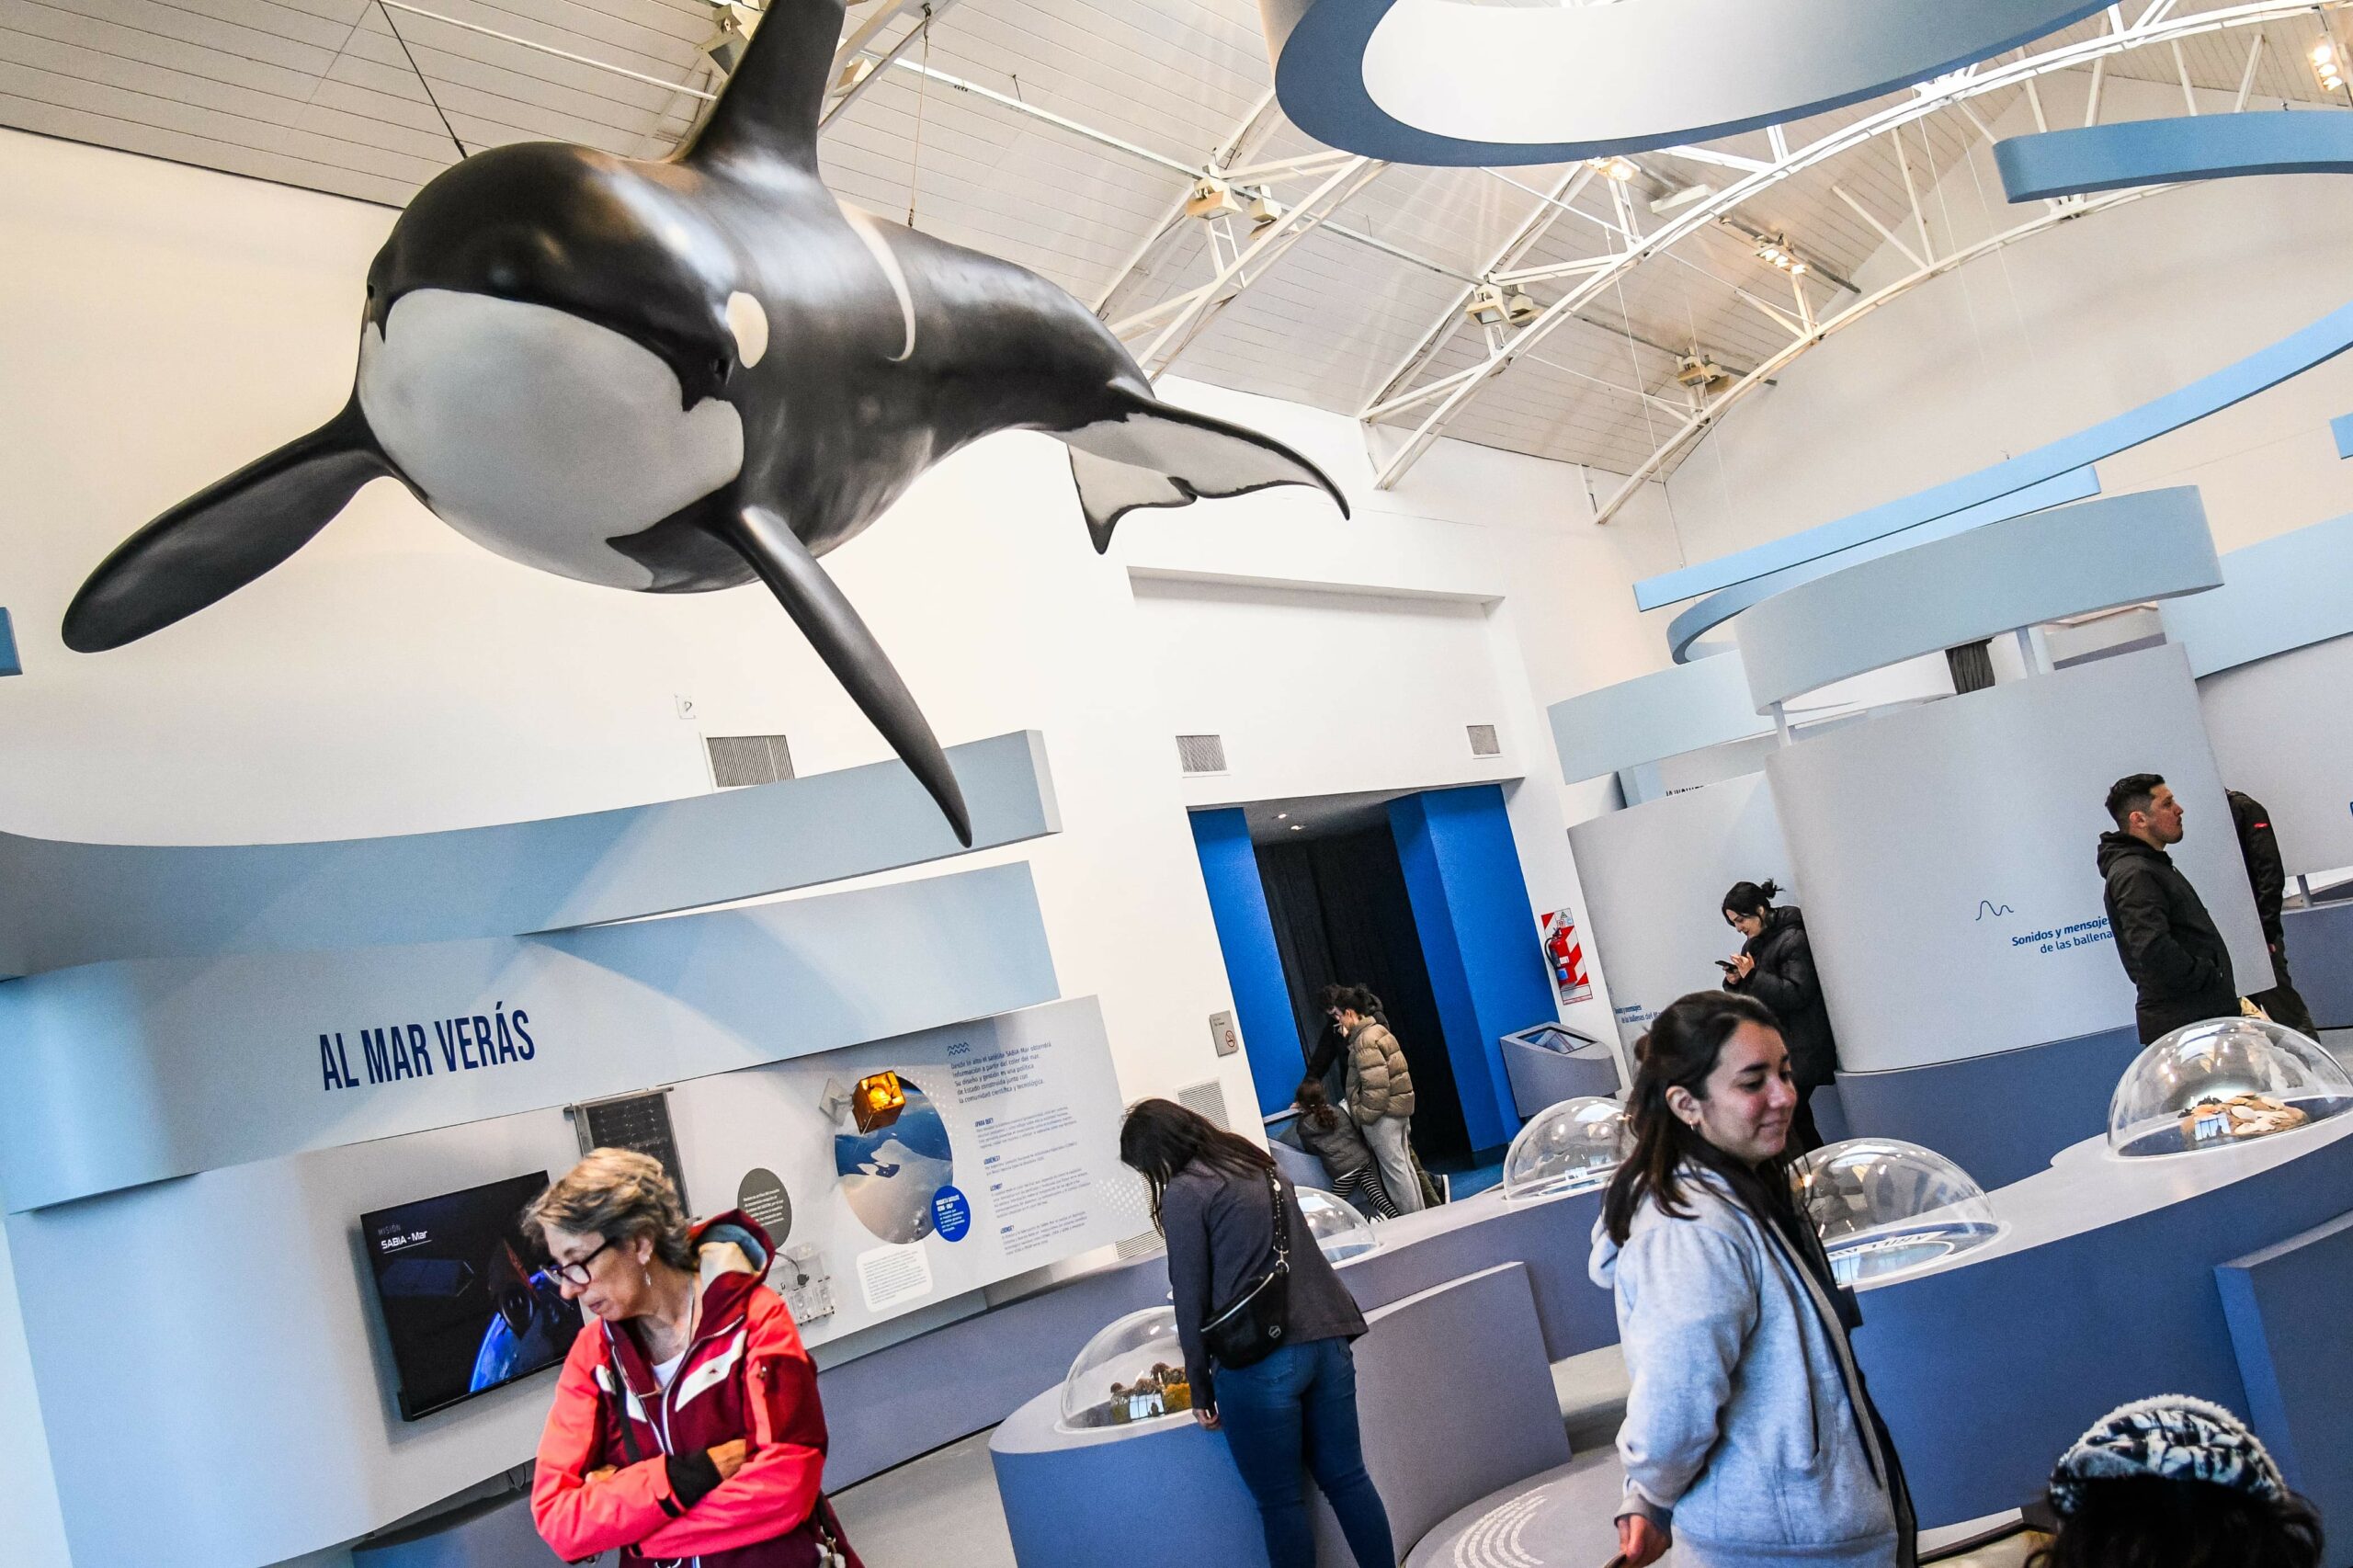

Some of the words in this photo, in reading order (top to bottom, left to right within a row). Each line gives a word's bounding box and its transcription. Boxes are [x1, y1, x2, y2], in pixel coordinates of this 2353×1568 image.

[2012, 931, 2053, 946] Sonidos
[2055, 928, 2062, 938] y
[2063, 916, 2110, 935] mensaje
[2040, 944, 2053, 954] de
[2056, 940, 2072, 950] las
[2074, 930, 2113, 946] ballena
[319, 1032, 359, 1090] AL
[360, 1023, 433, 1084] MAR
[434, 1001, 535, 1072] VERÁS
[381, 1235, 407, 1250] SABIA
[411, 1230, 428, 1242] Mar
